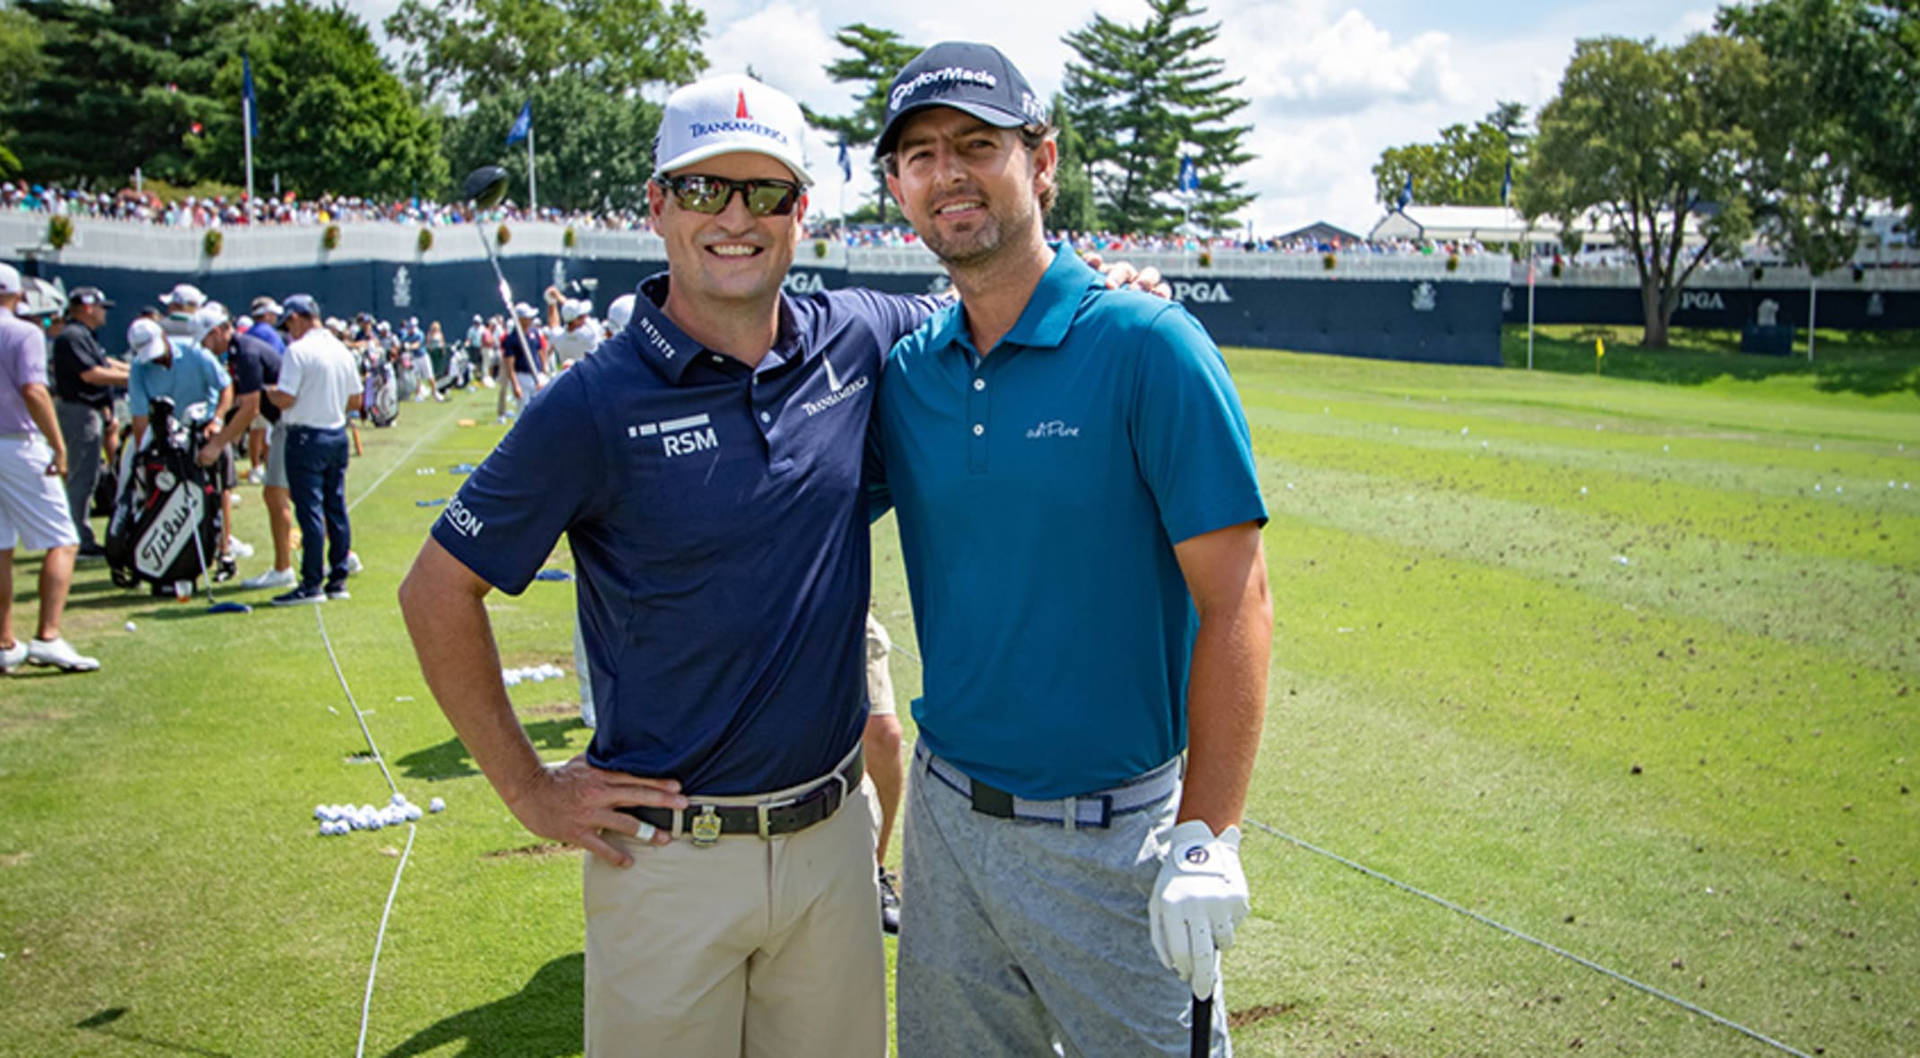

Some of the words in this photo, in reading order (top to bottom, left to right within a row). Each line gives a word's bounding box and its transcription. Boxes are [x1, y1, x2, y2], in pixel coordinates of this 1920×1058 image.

[1173, 281, 1233, 302] PGA
[1681, 291, 1724, 310] PGA
[662, 427, 719, 457] RSM
